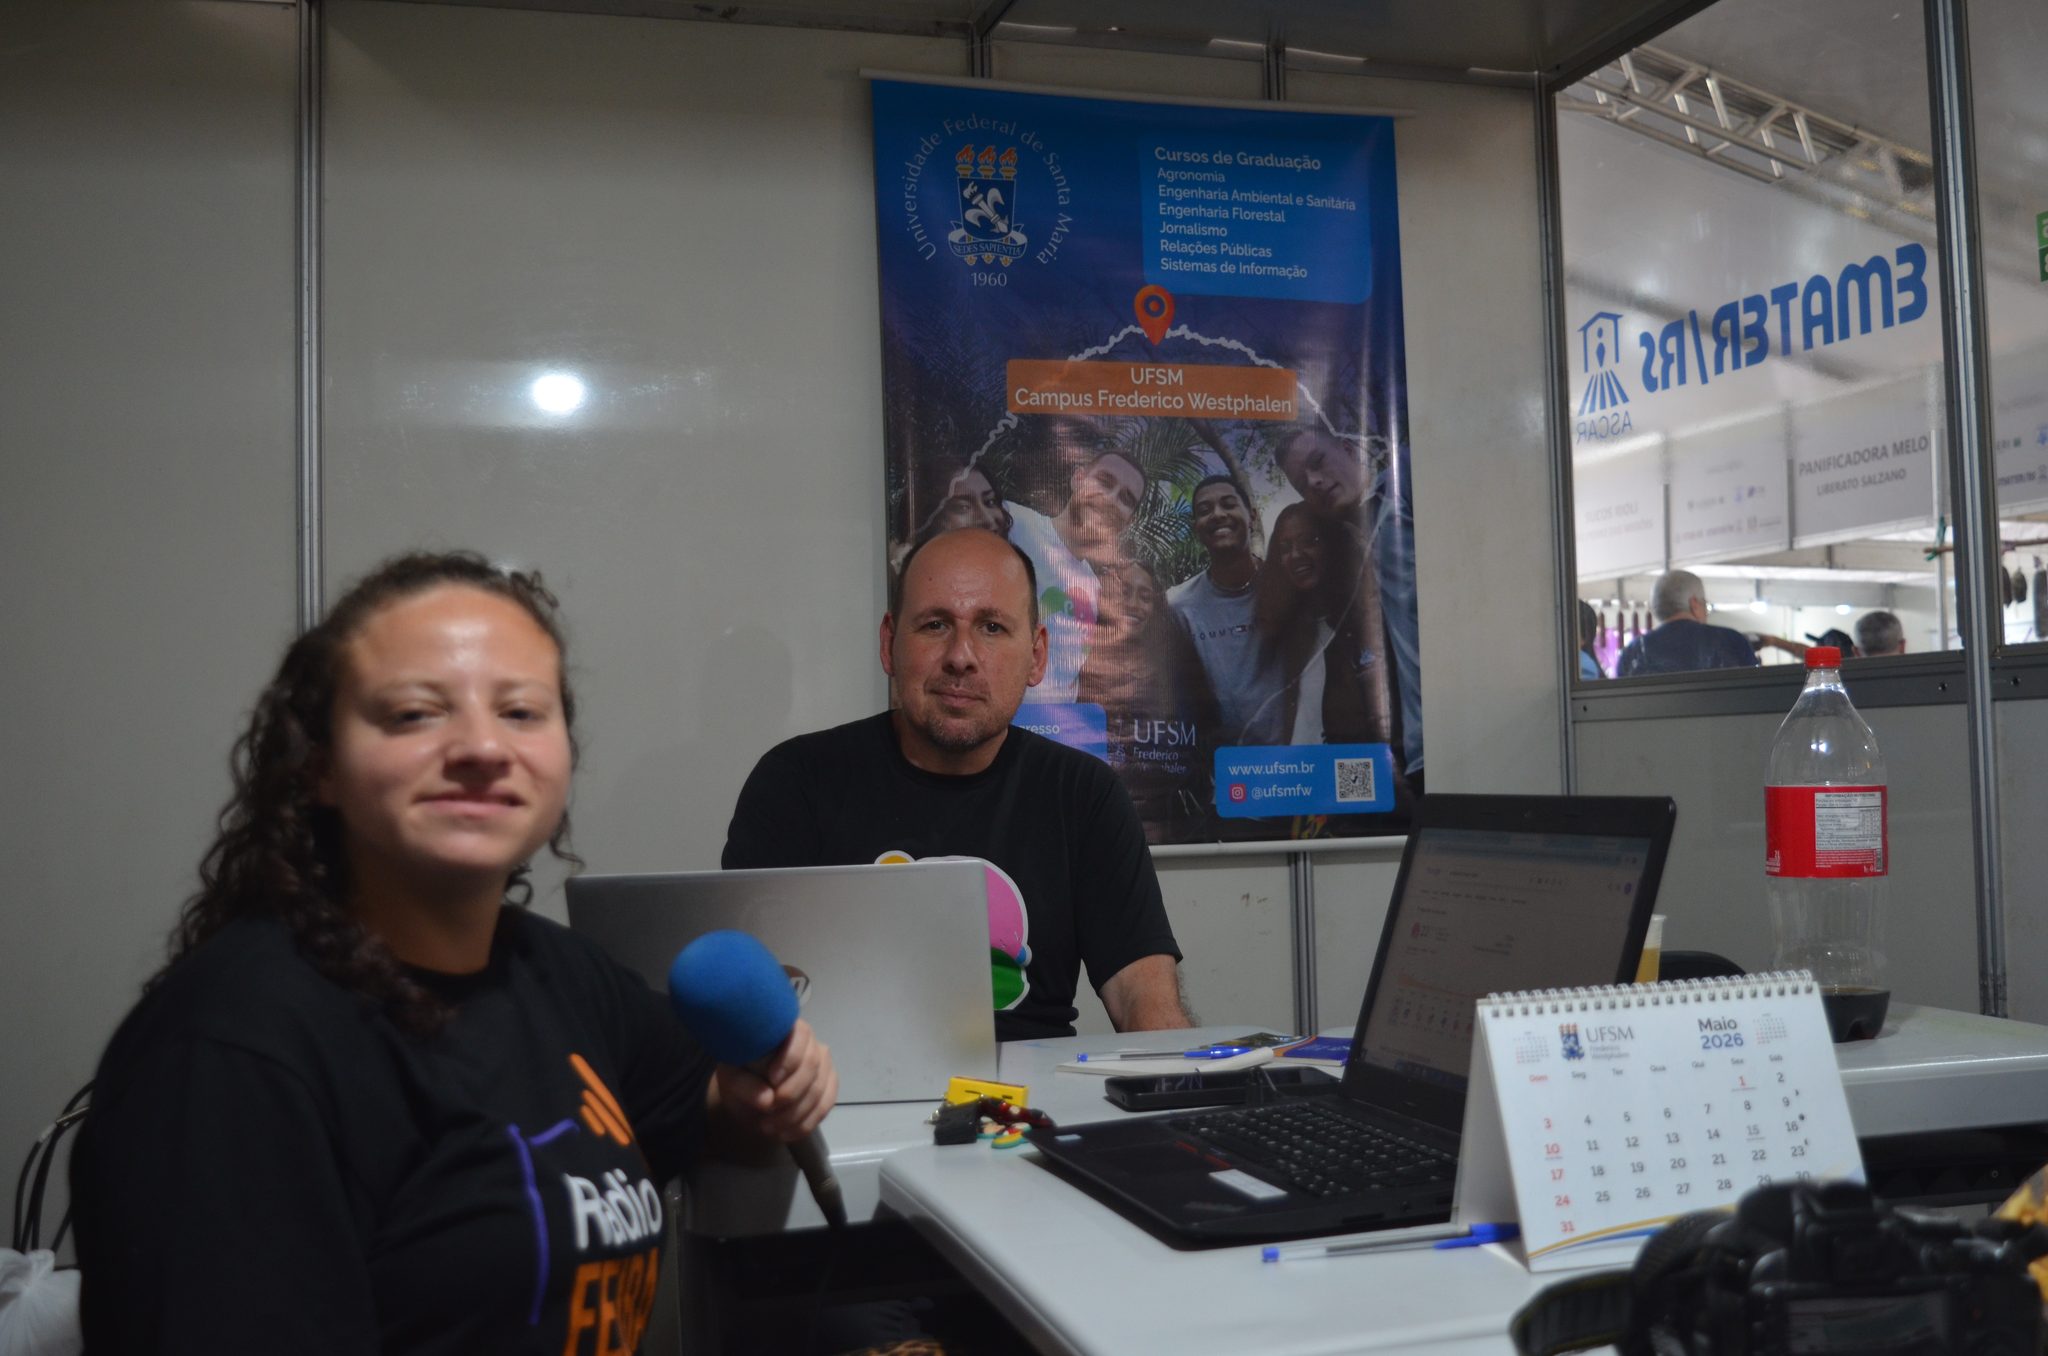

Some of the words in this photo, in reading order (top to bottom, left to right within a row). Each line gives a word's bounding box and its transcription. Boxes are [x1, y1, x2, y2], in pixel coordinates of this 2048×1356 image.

[943, 112, 1017, 137] Federal
[1020, 130, 1044, 153] de
[1154, 146, 1209, 164] Cursos
[1212, 149, 1233, 165] de
[1236, 151, 1322, 172] Graduação
[1042, 151, 1071, 206] Santa
[1157, 167, 1226, 183] Agronomia
[904, 132, 943, 261] Universidade
[1158, 184, 1229, 201] Engenharia
[1231, 189, 1293, 206] Ambiental
[1295, 196, 1304, 206] e
[1306, 194, 1356, 211] Sanitária
[1159, 202, 1229, 219] Engenharia
[1232, 207, 1286, 223] Florestal
[1036, 212, 1073, 265] Maria
[1160, 221, 1228, 237] Jornalismo
[1160, 239, 1218, 255] Relações
[1220, 241, 1272, 258] Públicas
[970, 272, 1008, 287] 1960
[1160, 257, 1217, 273] Sistemas
[1219, 260, 1236, 274] de
[1239, 262, 1308, 280] Informação
[1130, 366, 1184, 386] UFSM
[1015, 388, 1093, 411] Campus
[1098, 390, 1184, 410] Frederico
[1188, 393, 1292, 415] Westphalen
[1798, 445, 1889, 477] PANIFICADORA
[1891, 435, 1929, 458] MELO
[1860, 468, 1907, 488] SALZANO
[1133, 718, 1196, 746] UFSM
[1133, 746, 1179, 761] Frederico
[1228, 761, 1315, 776] www.ufsm.br
[1251, 784, 1312, 799] @ufsmfw
[1585, 1025, 1635, 1043] UFSM
[1697, 1015, 1738, 1033] Maio
[1700, 1033, 1745, 1049] 2026
[1739, 1075, 1746, 1086] 1
[1776, 1072, 1785, 1083] 2
[1544, 1117, 1552, 1130] 3
[1584, 1114, 1592, 1125] 4
[1623, 1111, 1631, 1122] 5
[1663, 1107, 1672, 1119] 6
[1704, 1103, 1711, 1114] 7
[1743, 1100, 1752, 1111] 8
[1782, 1096, 1790, 1107] 9
[1544, 1143, 1561, 1155] 10
[1586, 1139, 1599, 1151] 11
[1625, 1136, 1640, 1148] 12
[1665, 1132, 1680, 1144] 13
[1706, 1128, 1720, 1140] 14
[1746, 1124, 1760, 1136] 15
[1785, 1120, 1799, 1132] 16
[1550, 1168, 1564, 1180] 17
[1590, 1165, 1605, 1177] 18
[1630, 1161, 1645, 1173] 19
[1670, 1157, 1686, 1169] 20
[1712, 1153, 1726, 1165] 21
[1751, 1149, 1767, 1161] 22
[1791, 1145, 1805, 1157] 23
[1554, 1194, 1570, 1207] 24
[1595, 1190, 1610, 1202] 25
[1635, 1186, 1650, 1198] 26
[1676, 1183, 1690, 1195] 27
[1717, 1179, 1732, 1191] 28
[1757, 1174, 1772, 1187] 29
[1560, 1220, 1575, 1233] 31
